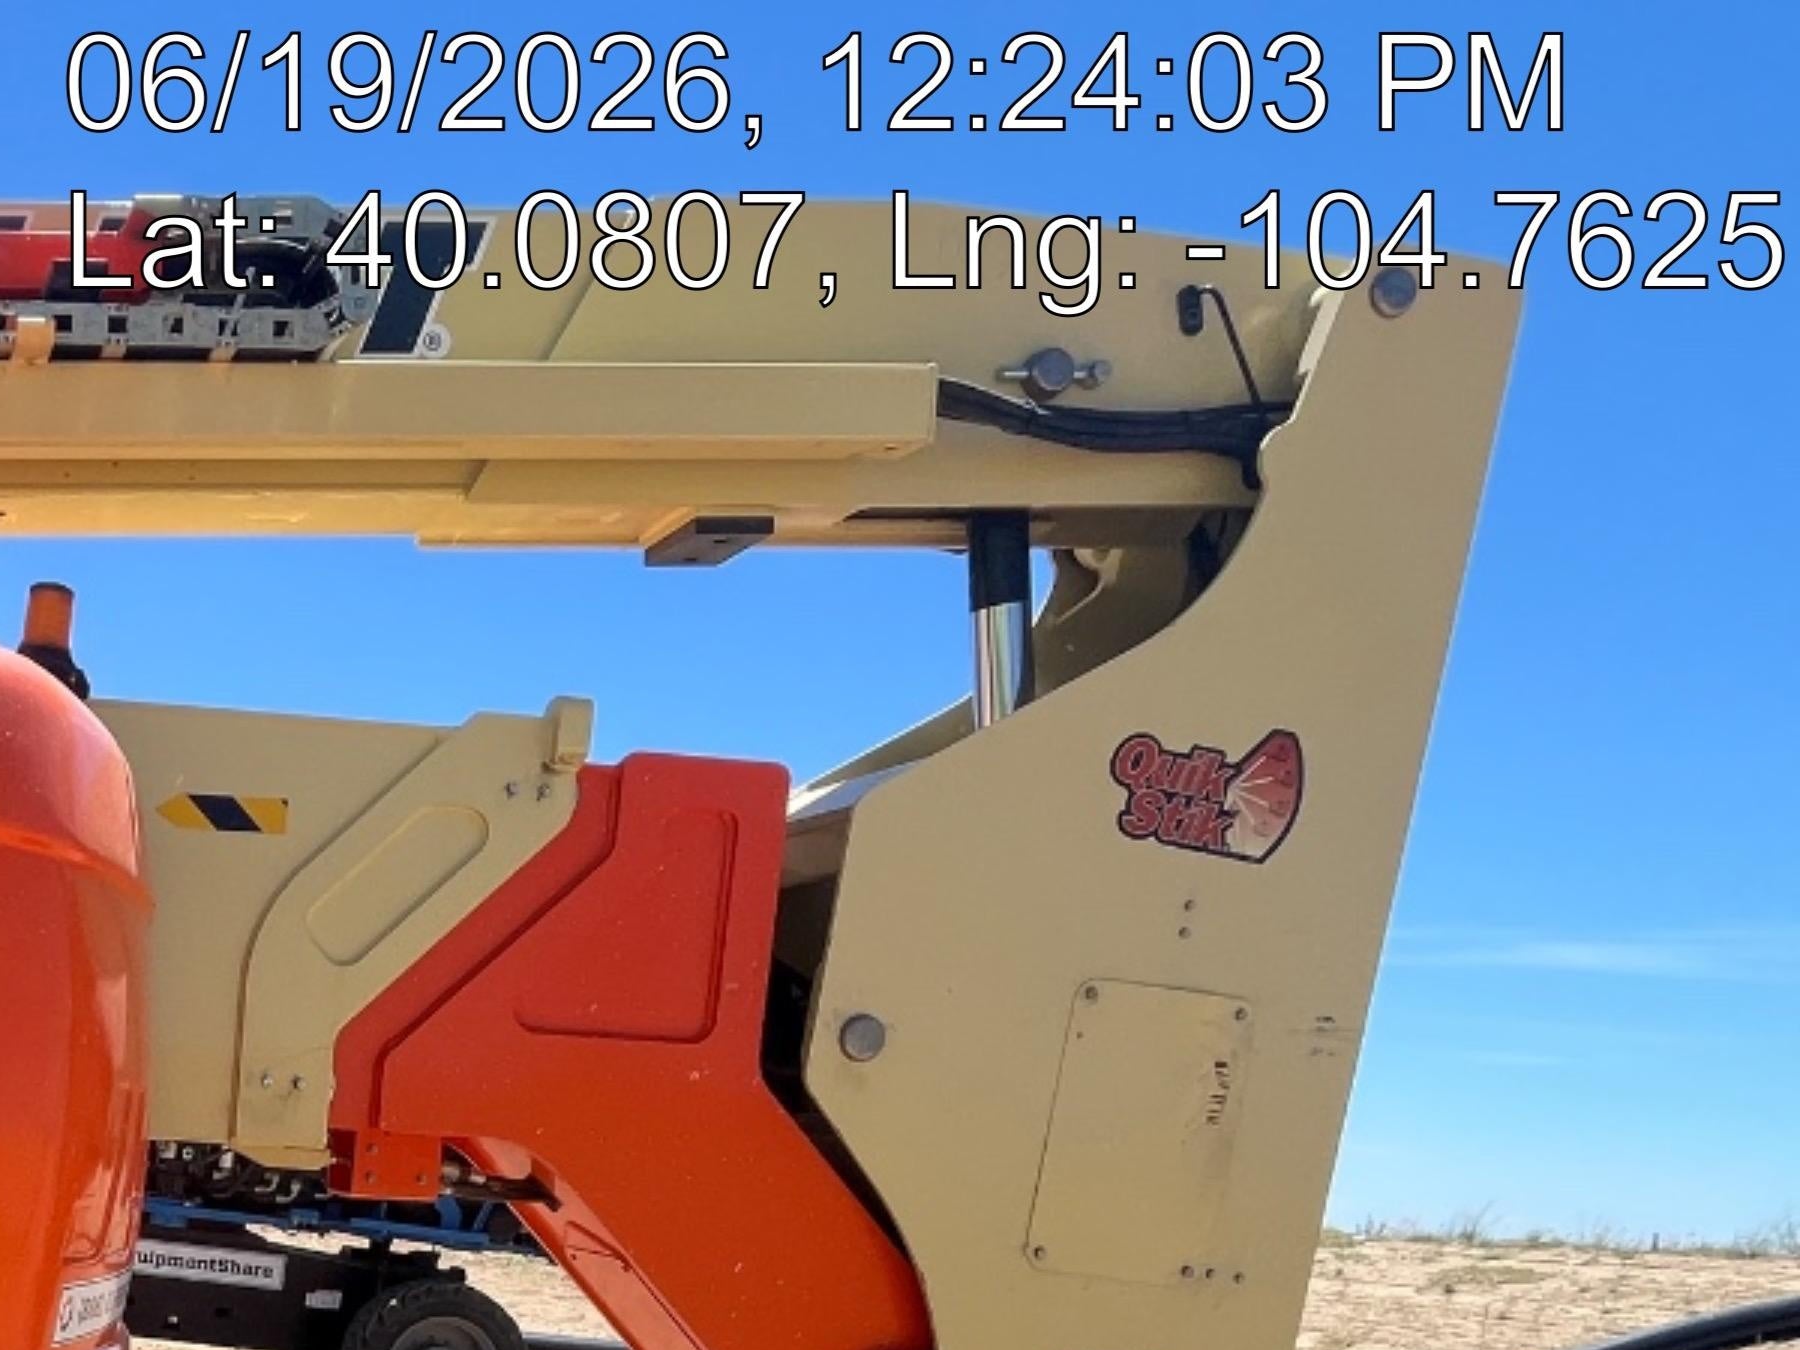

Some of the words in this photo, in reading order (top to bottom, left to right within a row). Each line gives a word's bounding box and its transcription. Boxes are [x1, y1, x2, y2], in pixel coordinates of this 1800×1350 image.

[1114, 736, 1234, 802] Quik
[1121, 789, 1234, 851] Stik
[136, 1249, 275, 1279] uipmentShare
